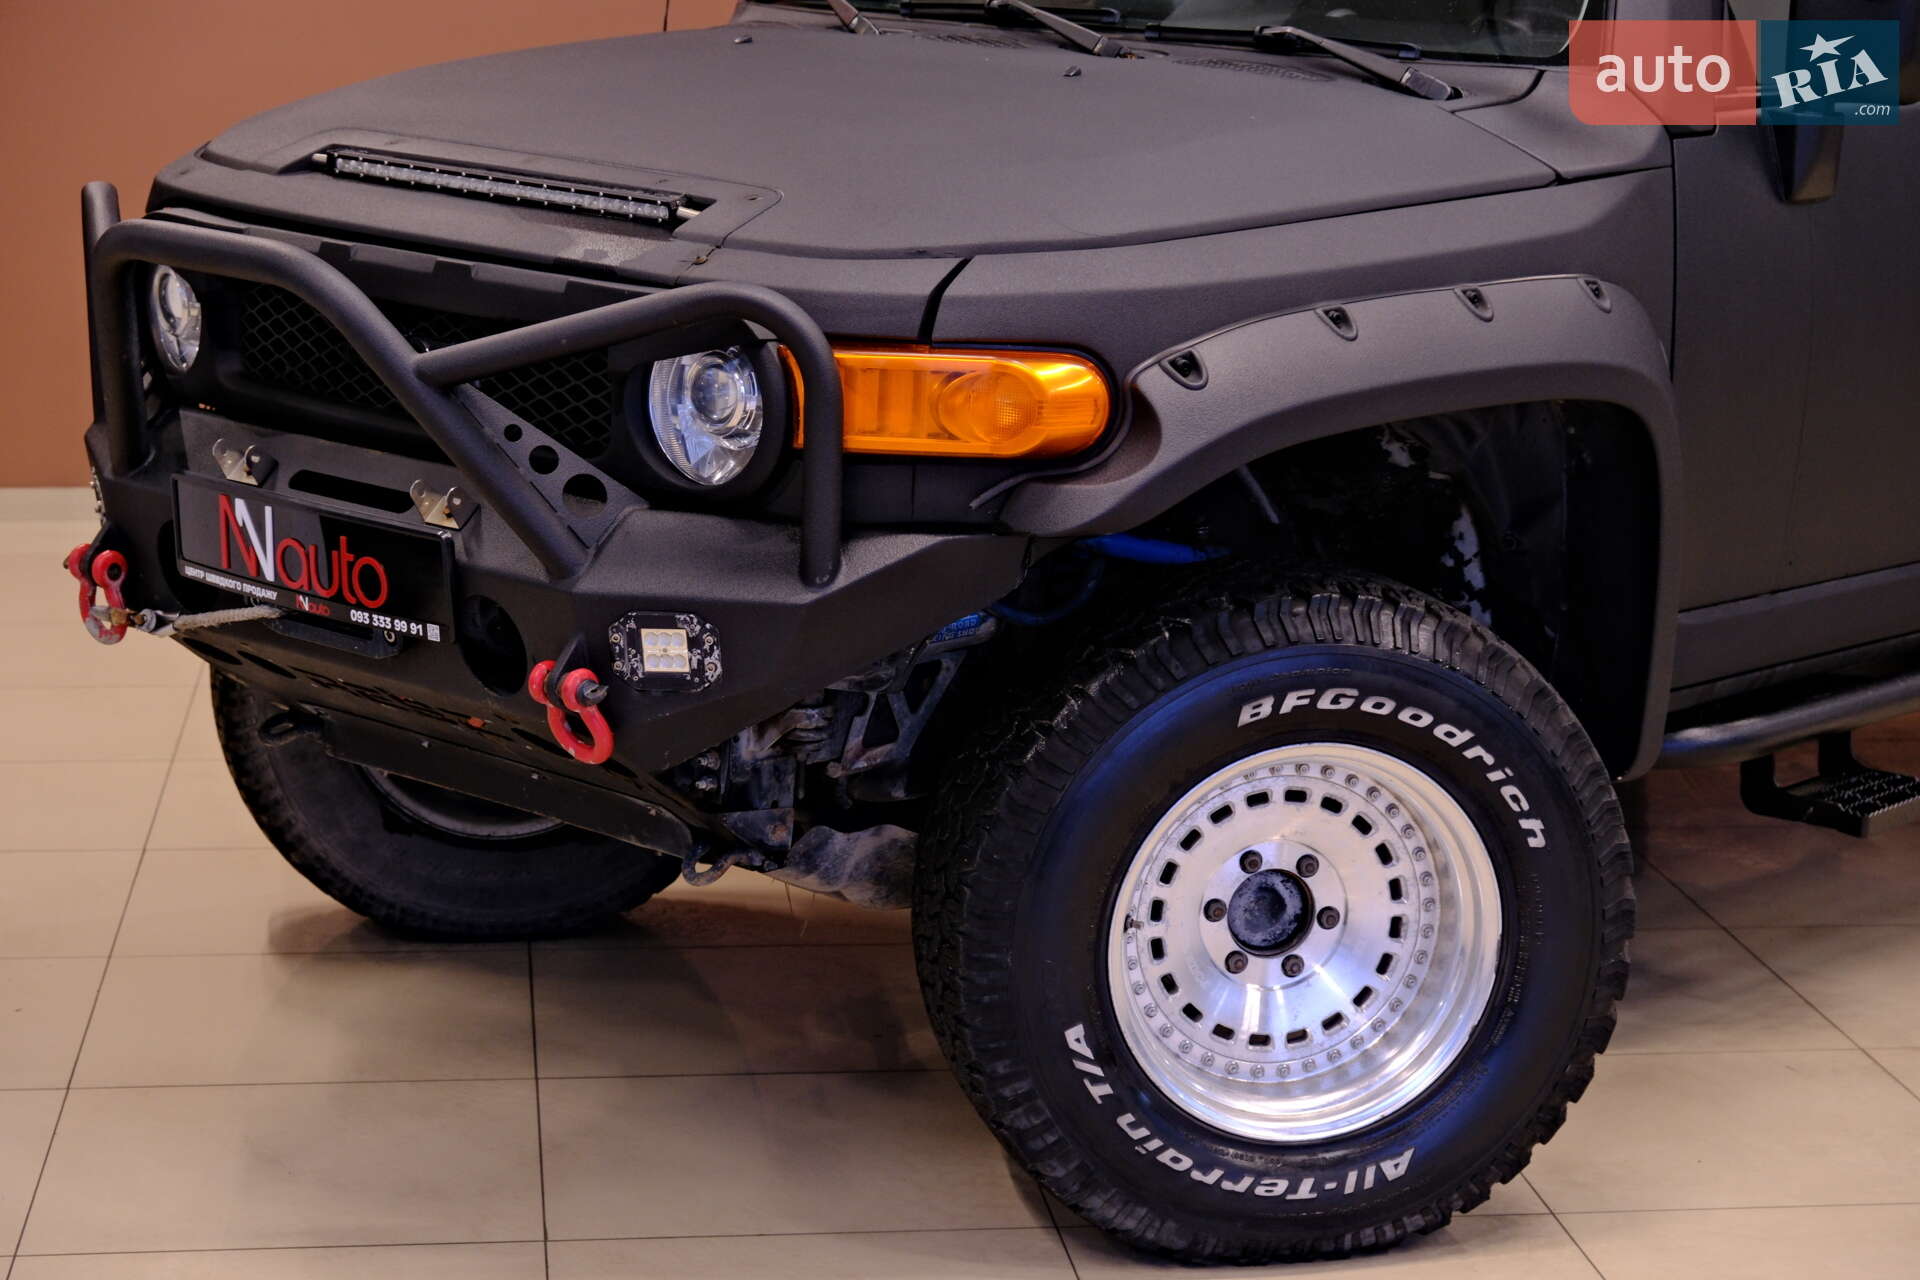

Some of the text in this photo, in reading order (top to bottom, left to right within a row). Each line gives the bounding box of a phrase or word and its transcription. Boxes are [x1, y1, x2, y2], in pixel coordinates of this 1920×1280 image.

[350, 609, 423, 636] 093 333 99 91
[1237, 687, 1547, 849] BFGoodrich
[1064, 1023, 1114, 1105] T/A
[1116, 1112, 1415, 1200] All-Terrain
